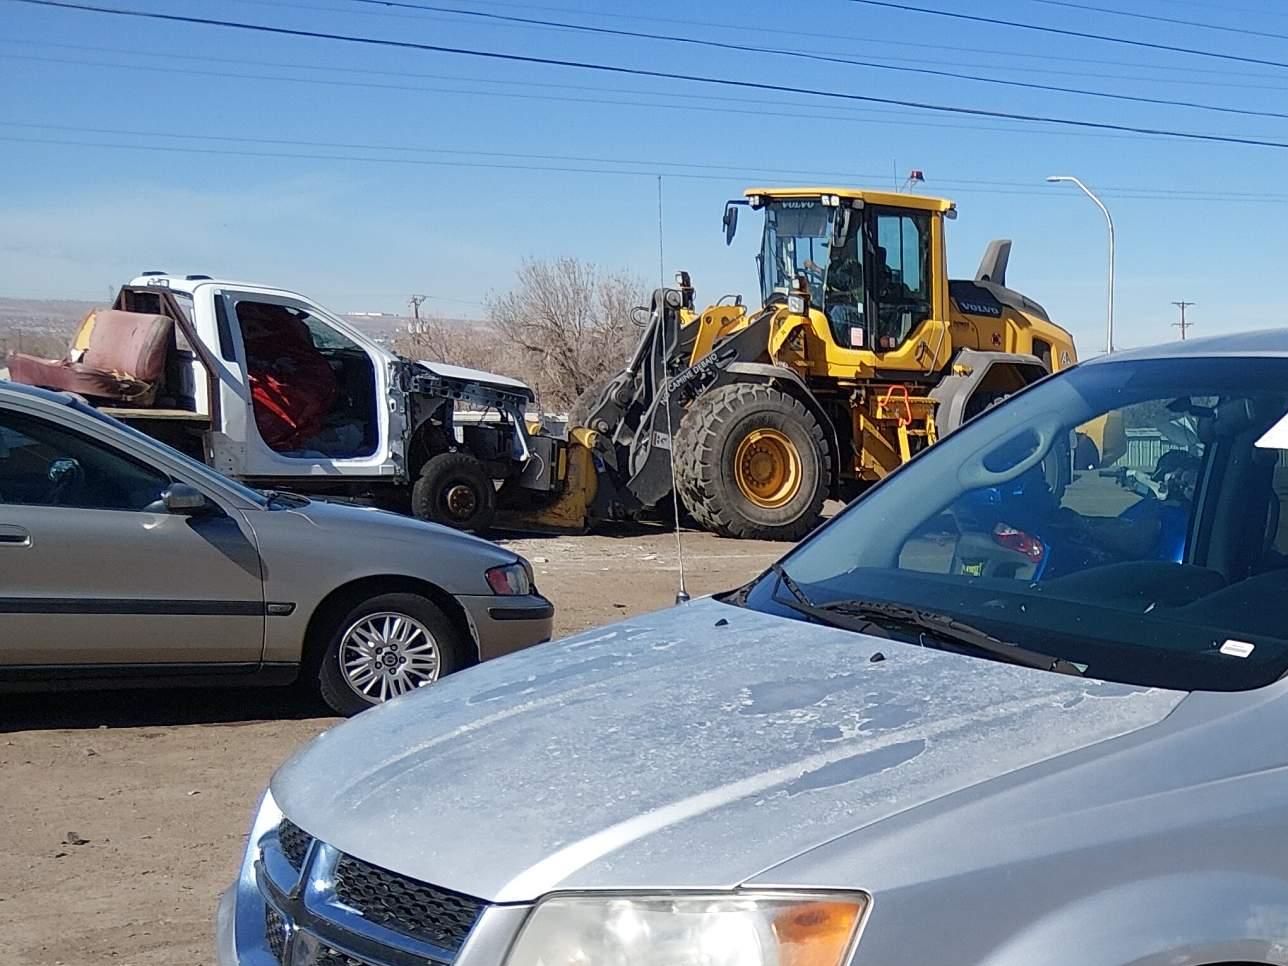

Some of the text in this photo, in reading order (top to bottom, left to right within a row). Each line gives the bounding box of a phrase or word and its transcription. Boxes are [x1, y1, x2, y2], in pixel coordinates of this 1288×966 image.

[782, 201, 815, 209] VOLVO
[960, 302, 1000, 316] VOLVO
[668, 371, 694, 392] CAMINE
[693, 353, 718, 374] DEBAJO
